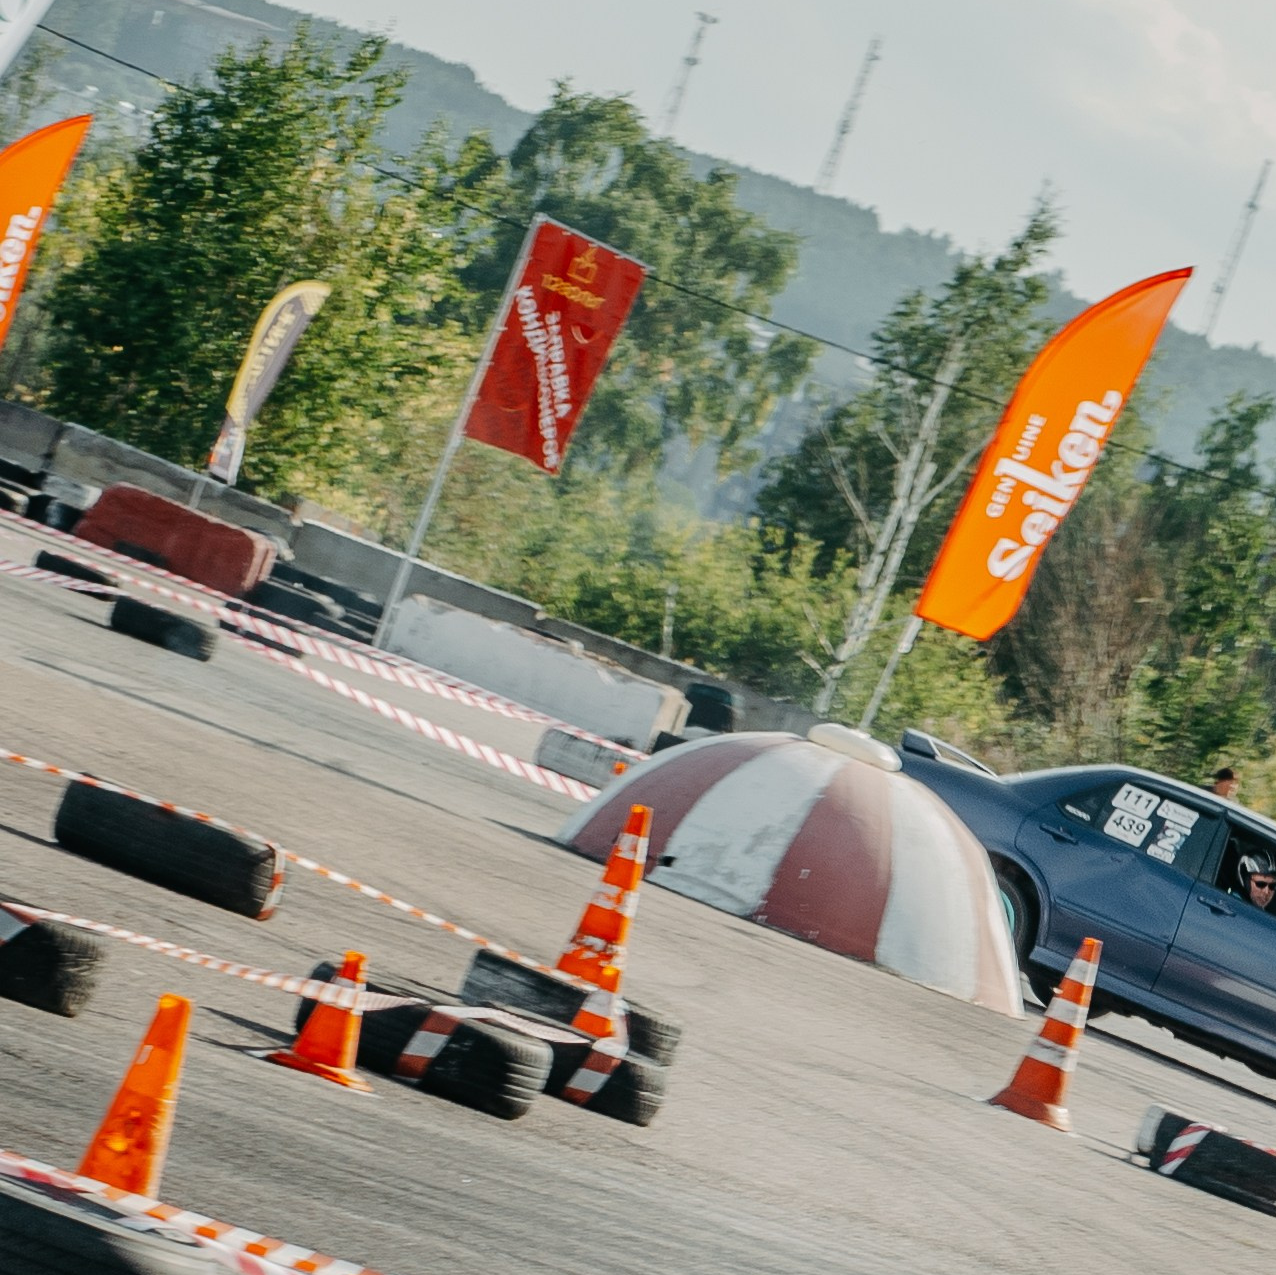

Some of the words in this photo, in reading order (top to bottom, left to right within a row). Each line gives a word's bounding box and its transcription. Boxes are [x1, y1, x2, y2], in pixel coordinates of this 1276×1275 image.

[986, 390, 1122, 581] Seiken
[1124, 789, 1153, 810] 111
[1112, 815, 1146, 836] 439
